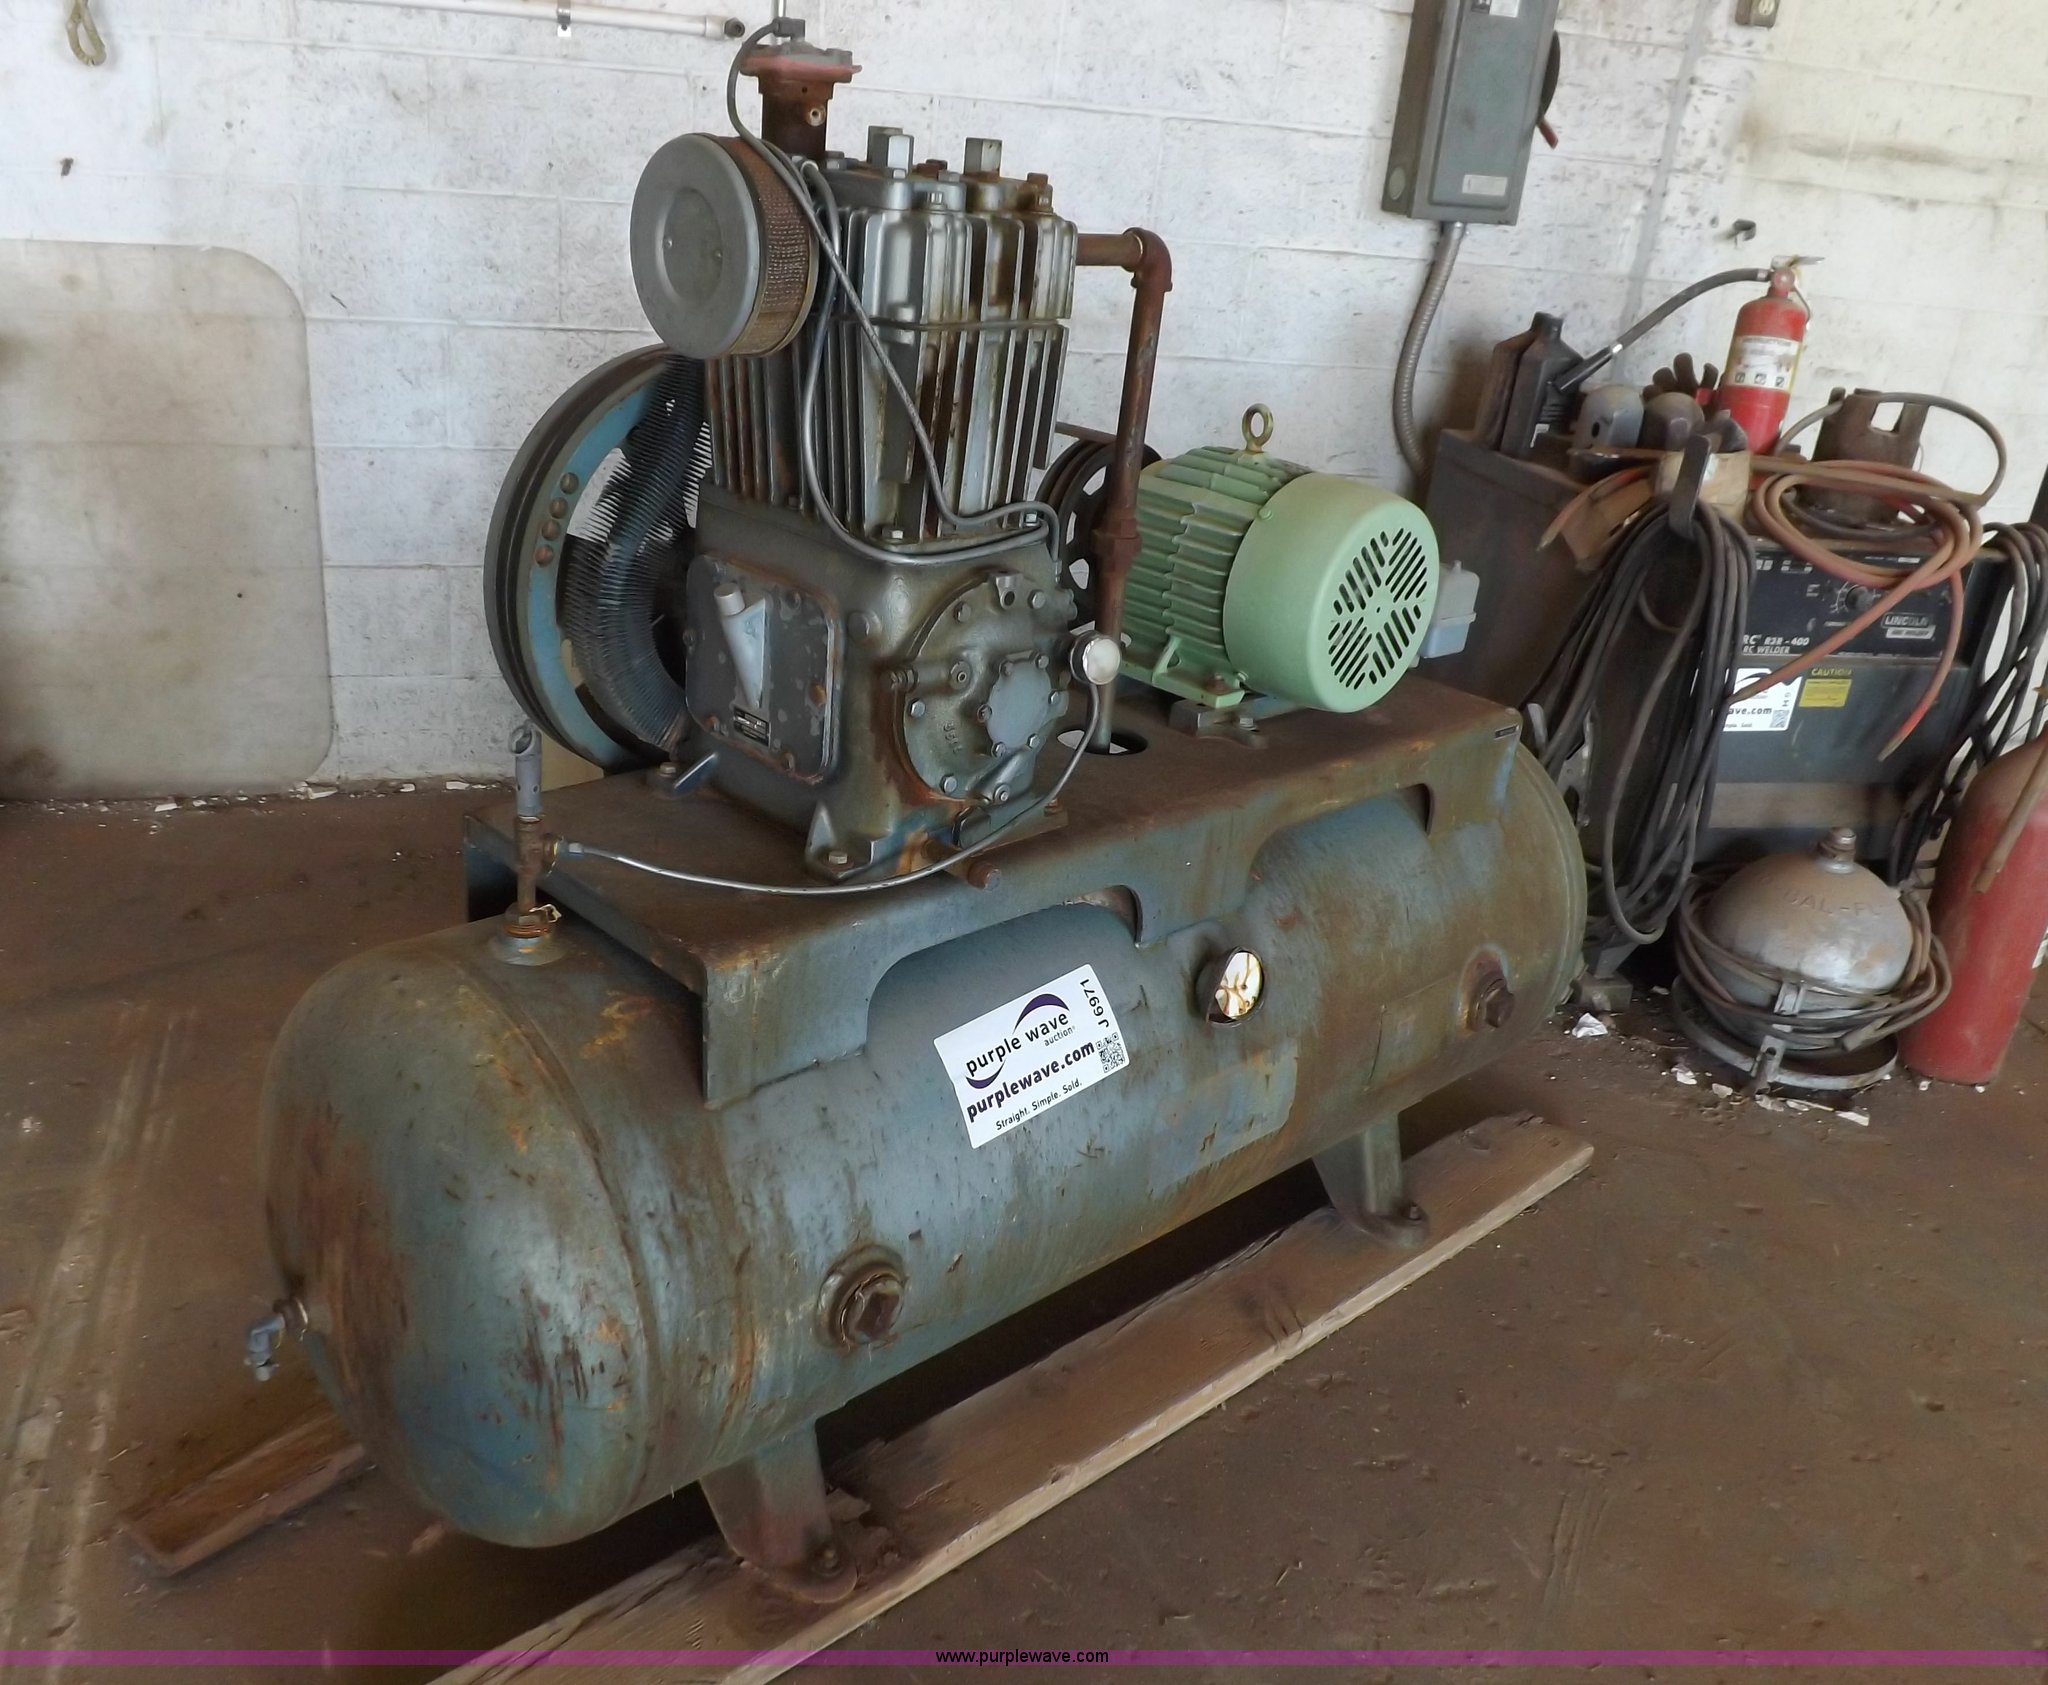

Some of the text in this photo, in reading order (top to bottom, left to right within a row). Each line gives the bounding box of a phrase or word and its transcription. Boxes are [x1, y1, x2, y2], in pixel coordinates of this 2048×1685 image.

[1743, 645, 1755, 654] RC
[1728, 707, 1772, 715] ave.com
[966, 1013, 1069, 1077] purple wave
[967, 1041, 1095, 1122] purplewave.com
[996, 1077, 1083, 1131] Straight. Simple. Sold.
